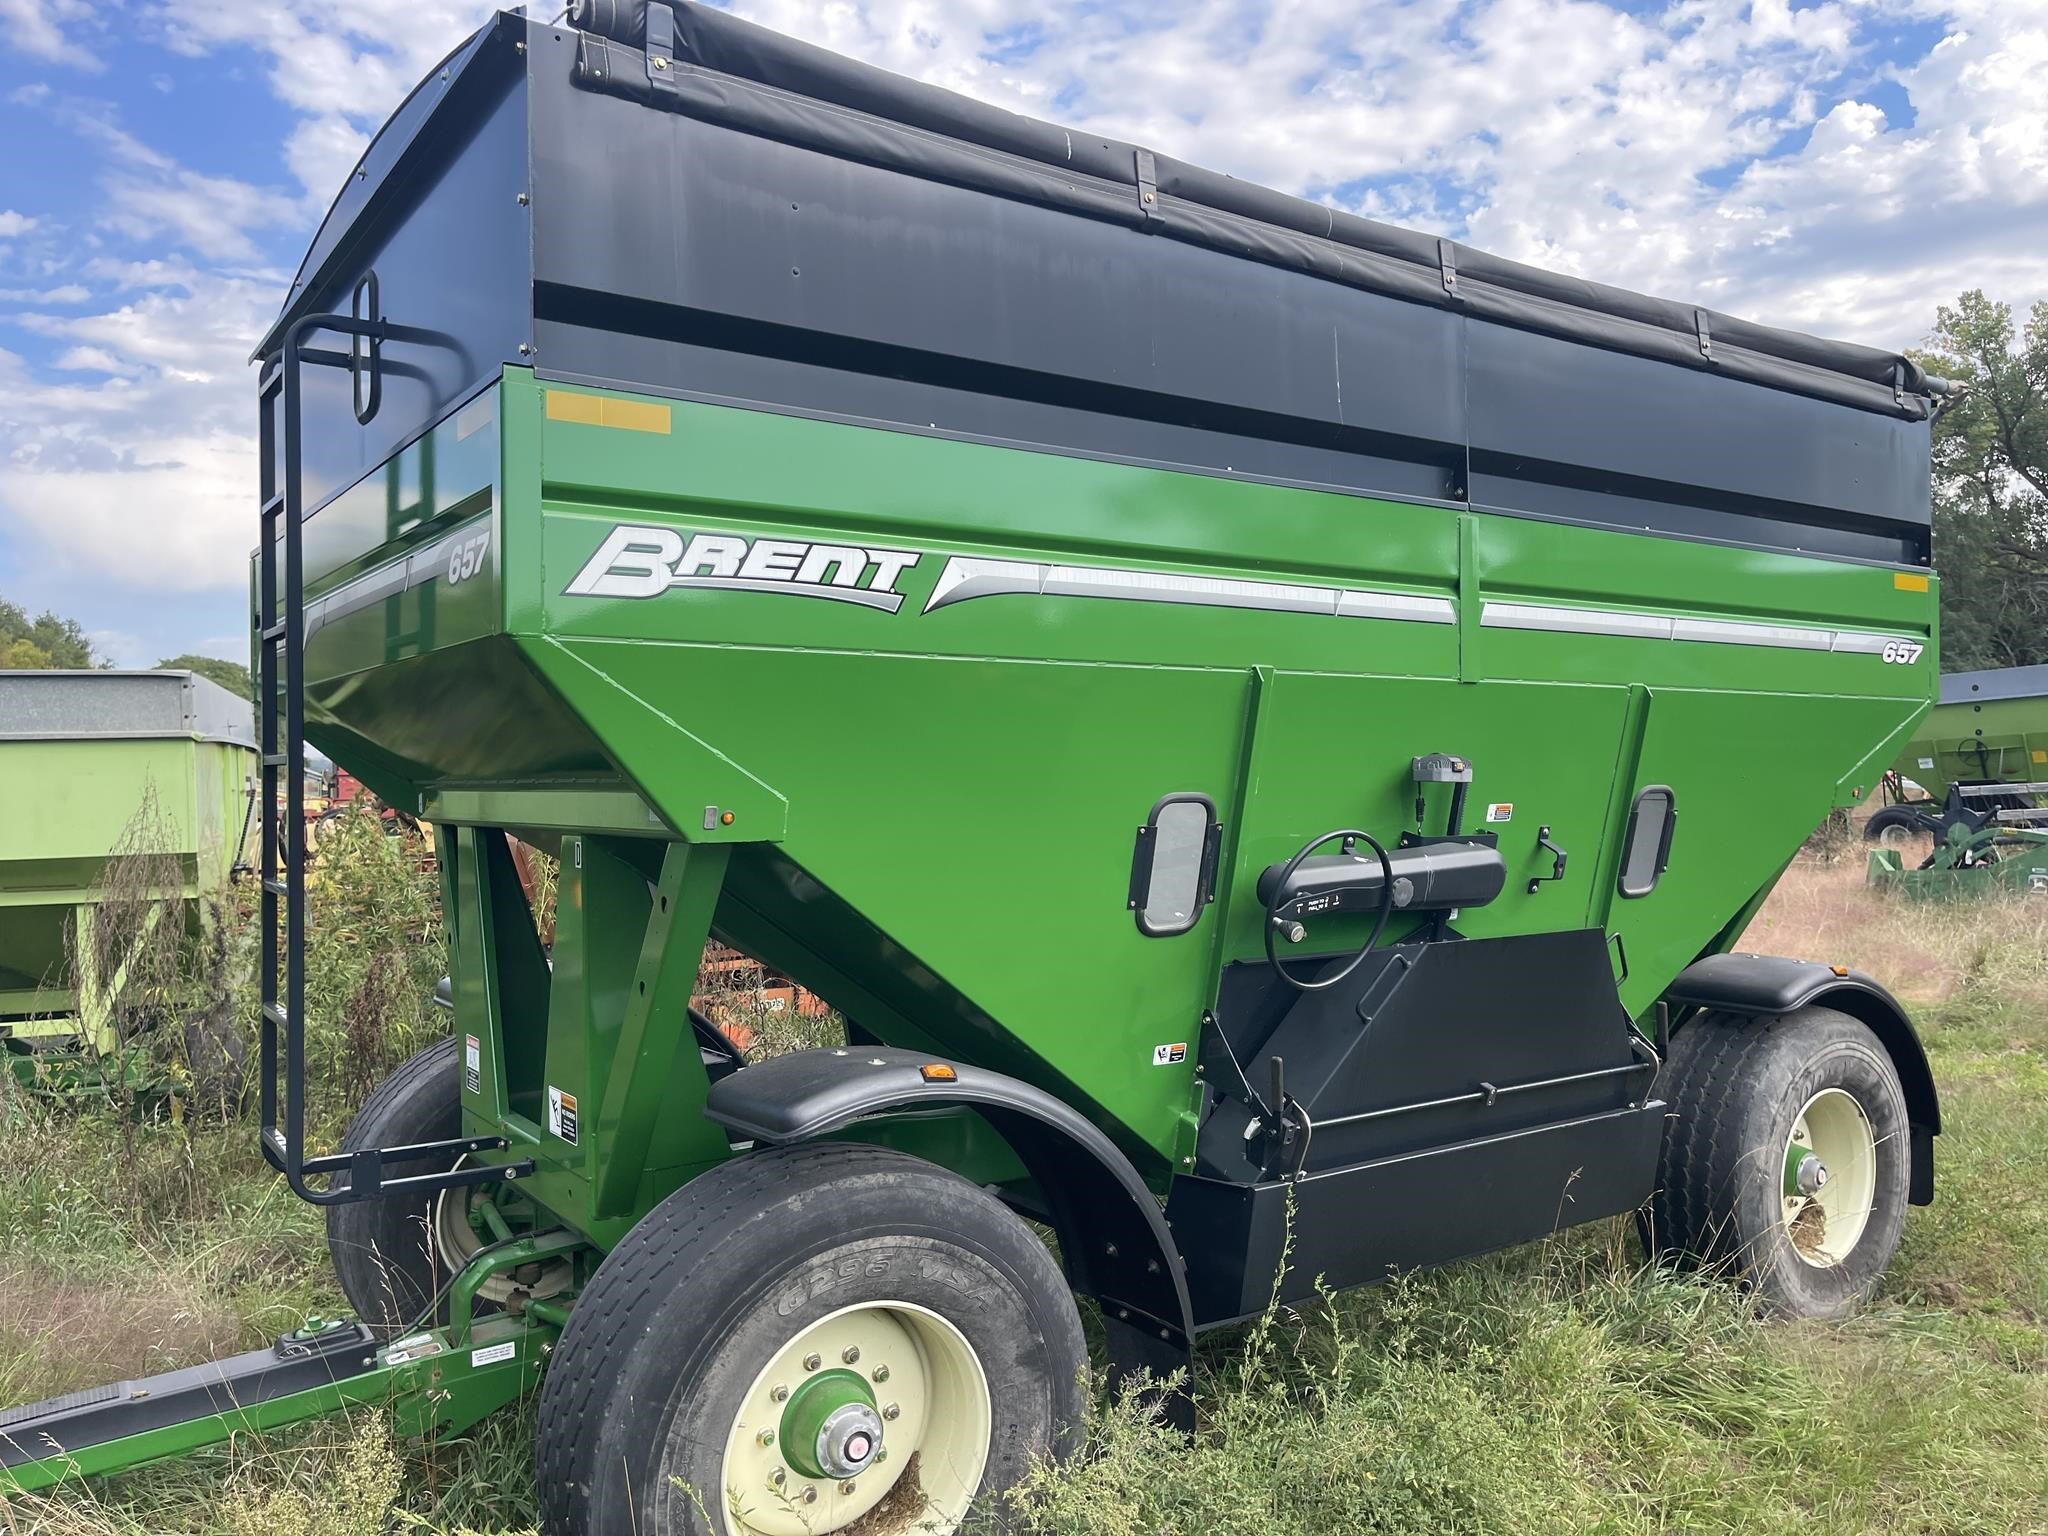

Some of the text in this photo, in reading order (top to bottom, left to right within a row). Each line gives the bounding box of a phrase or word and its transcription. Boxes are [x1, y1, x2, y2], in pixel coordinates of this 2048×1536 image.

[448, 530, 491, 585] 657
[560, 523, 923, 602] BRENT
[1882, 641, 1924, 665] 657
